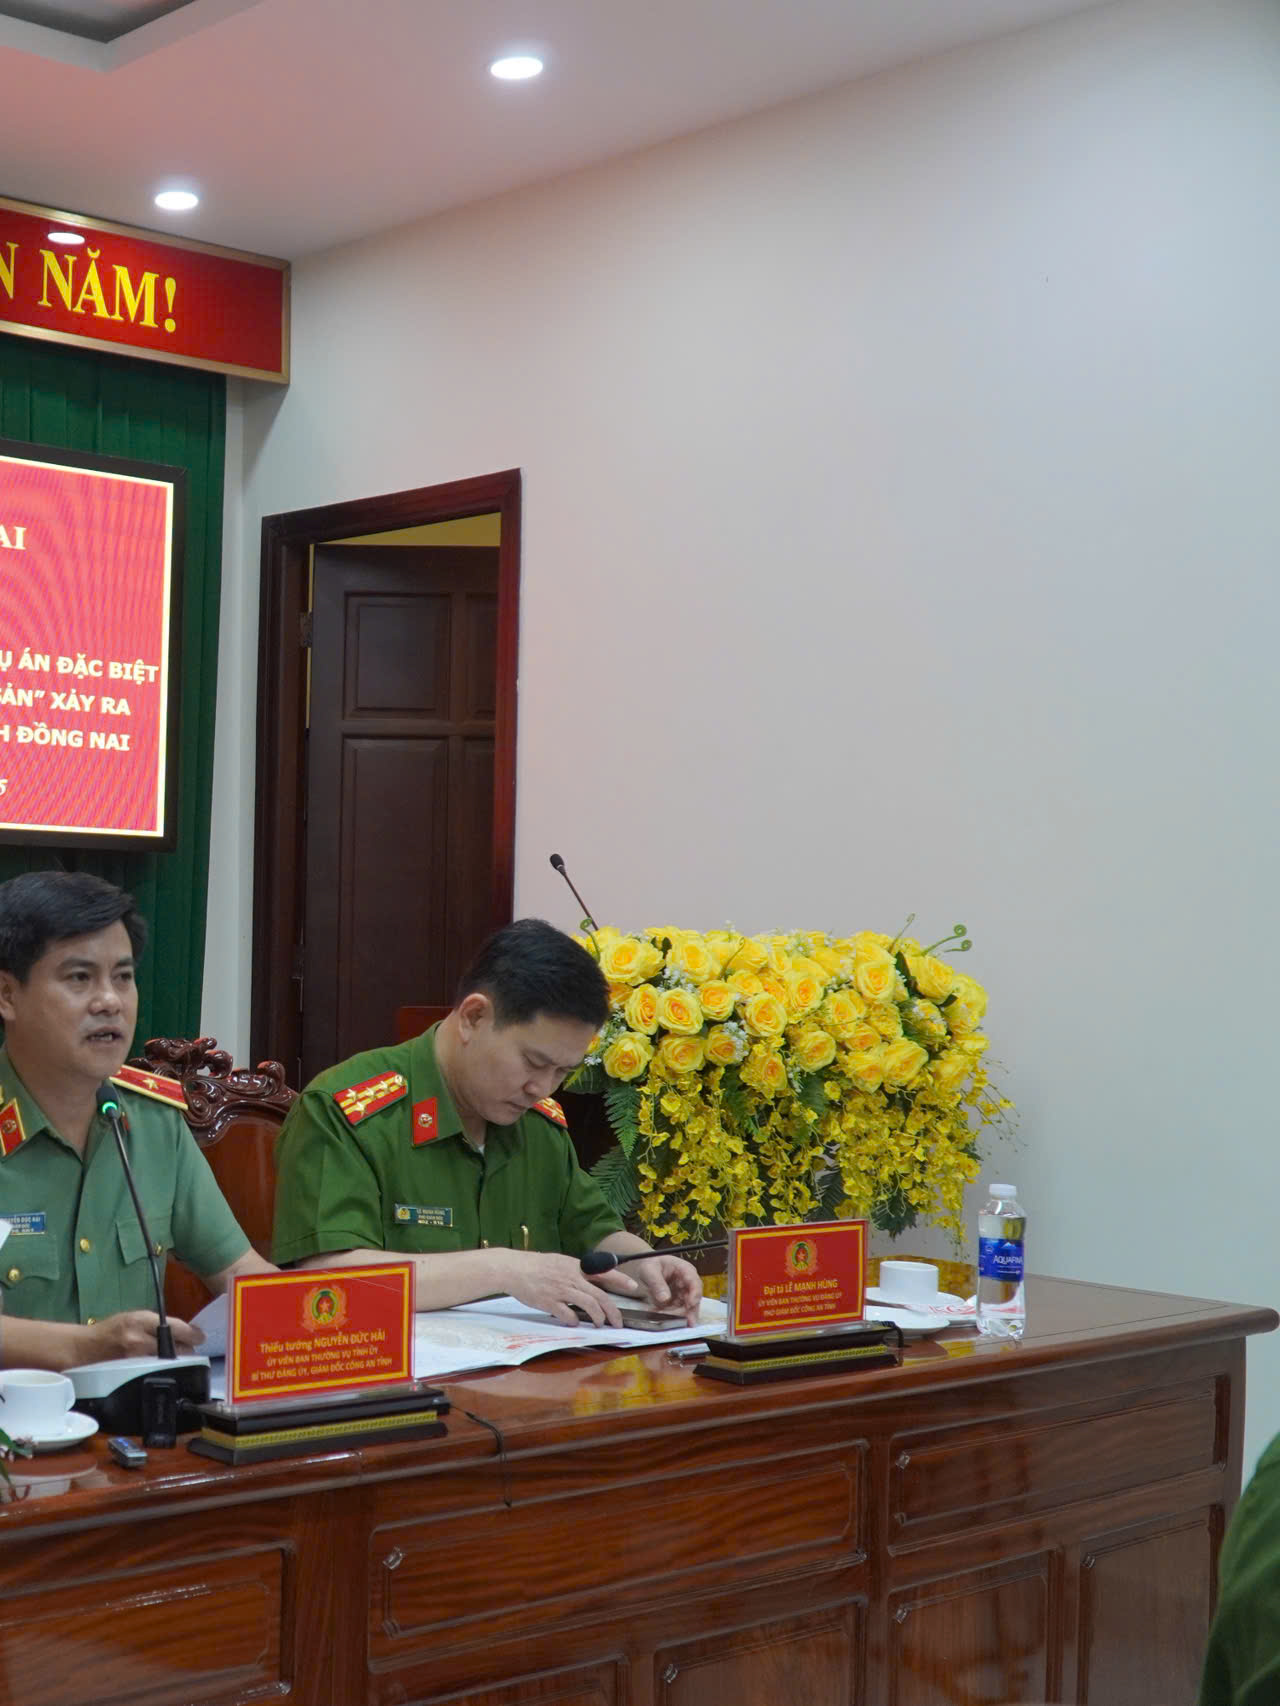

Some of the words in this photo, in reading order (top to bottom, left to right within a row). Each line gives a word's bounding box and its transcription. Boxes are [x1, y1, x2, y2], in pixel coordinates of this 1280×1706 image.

[38, 246, 178, 334] NĂM!
[18, 647, 50, 672] ÁN
[56, 653, 102, 679] ĐẶC
[109, 659, 159, 685] BIỆT
[51, 691, 95, 713] XẢY
[101, 695, 131, 716] RA
[16, 722, 83, 748] ĐỒNG
[90, 733, 131, 752] NAI
